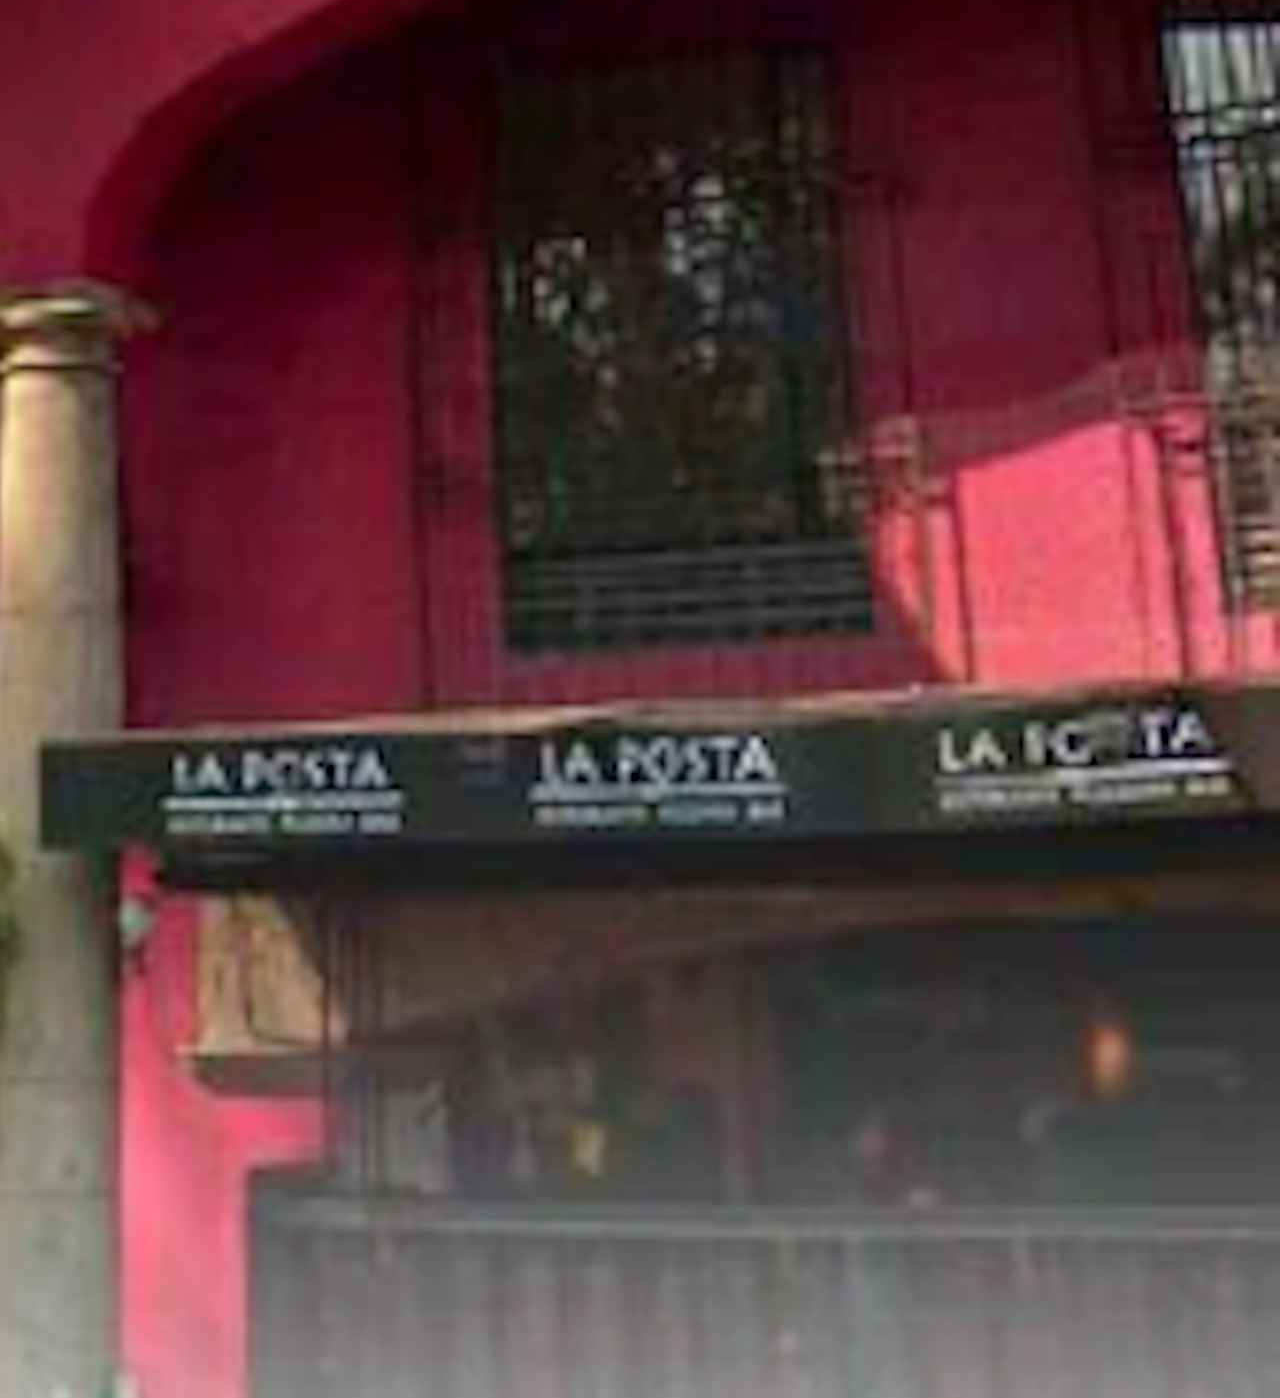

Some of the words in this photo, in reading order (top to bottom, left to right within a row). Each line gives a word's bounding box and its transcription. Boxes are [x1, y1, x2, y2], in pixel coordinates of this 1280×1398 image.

[540, 741, 601, 788] LA
[616, 735, 778, 785] POSTA
[940, 727, 1007, 773] LA
[1023, 710, 1214, 765] POTA
[172, 753, 229, 791] LA
[242, 749, 391, 789] POSTA
